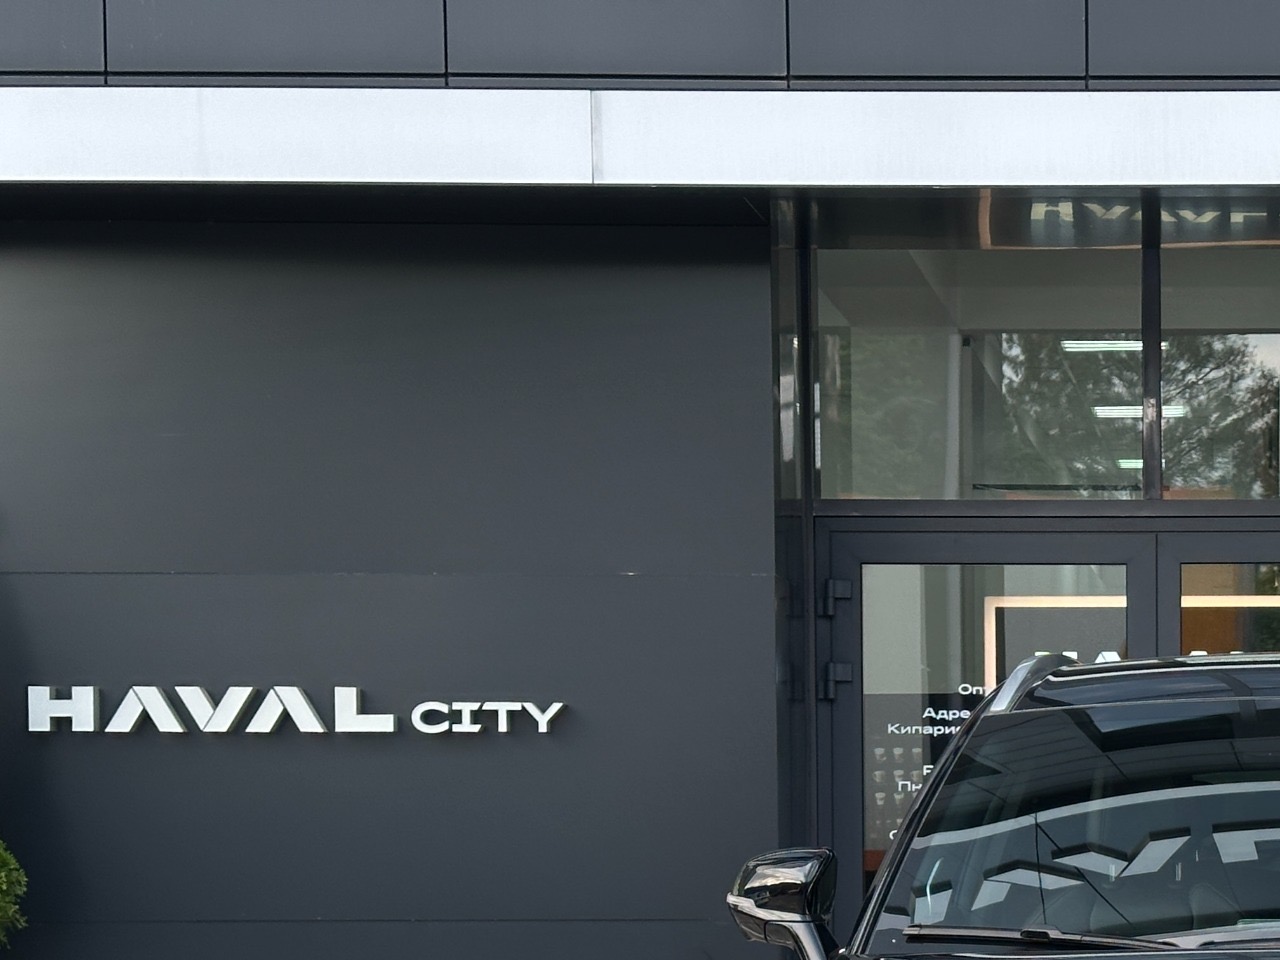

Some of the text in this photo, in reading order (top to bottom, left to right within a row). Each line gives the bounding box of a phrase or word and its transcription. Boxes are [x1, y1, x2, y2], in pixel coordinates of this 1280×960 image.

[28, 686, 564, 734] HAVAL CITY
[922, 707, 971, 721] Адре
